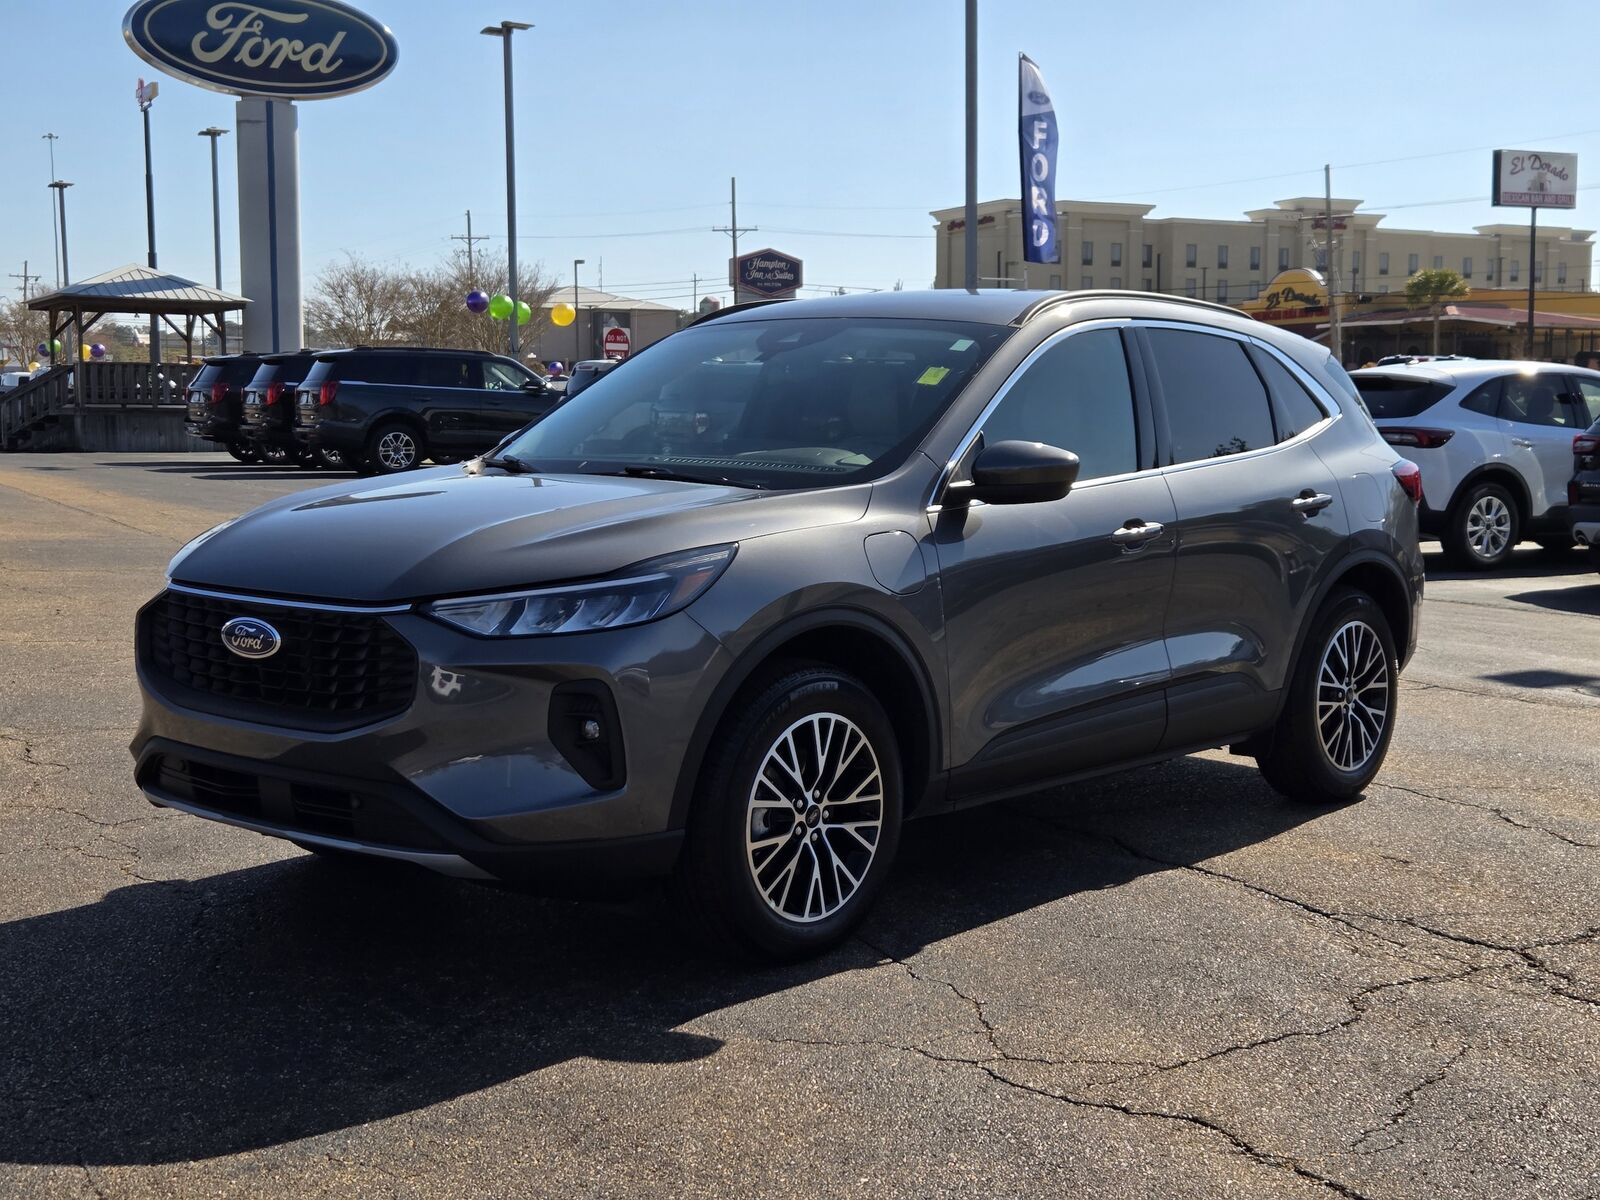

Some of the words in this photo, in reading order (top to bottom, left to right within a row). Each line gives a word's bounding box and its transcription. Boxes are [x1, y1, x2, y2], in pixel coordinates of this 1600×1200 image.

[191, 2, 347, 73] Ford
[1510, 156, 1525, 175] El
[1528, 154, 1569, 180] Dorado
[1031, 121, 1049, 246] FORD
[748, 257, 790, 270] Hampton
[232, 625, 264, 650] Ford
